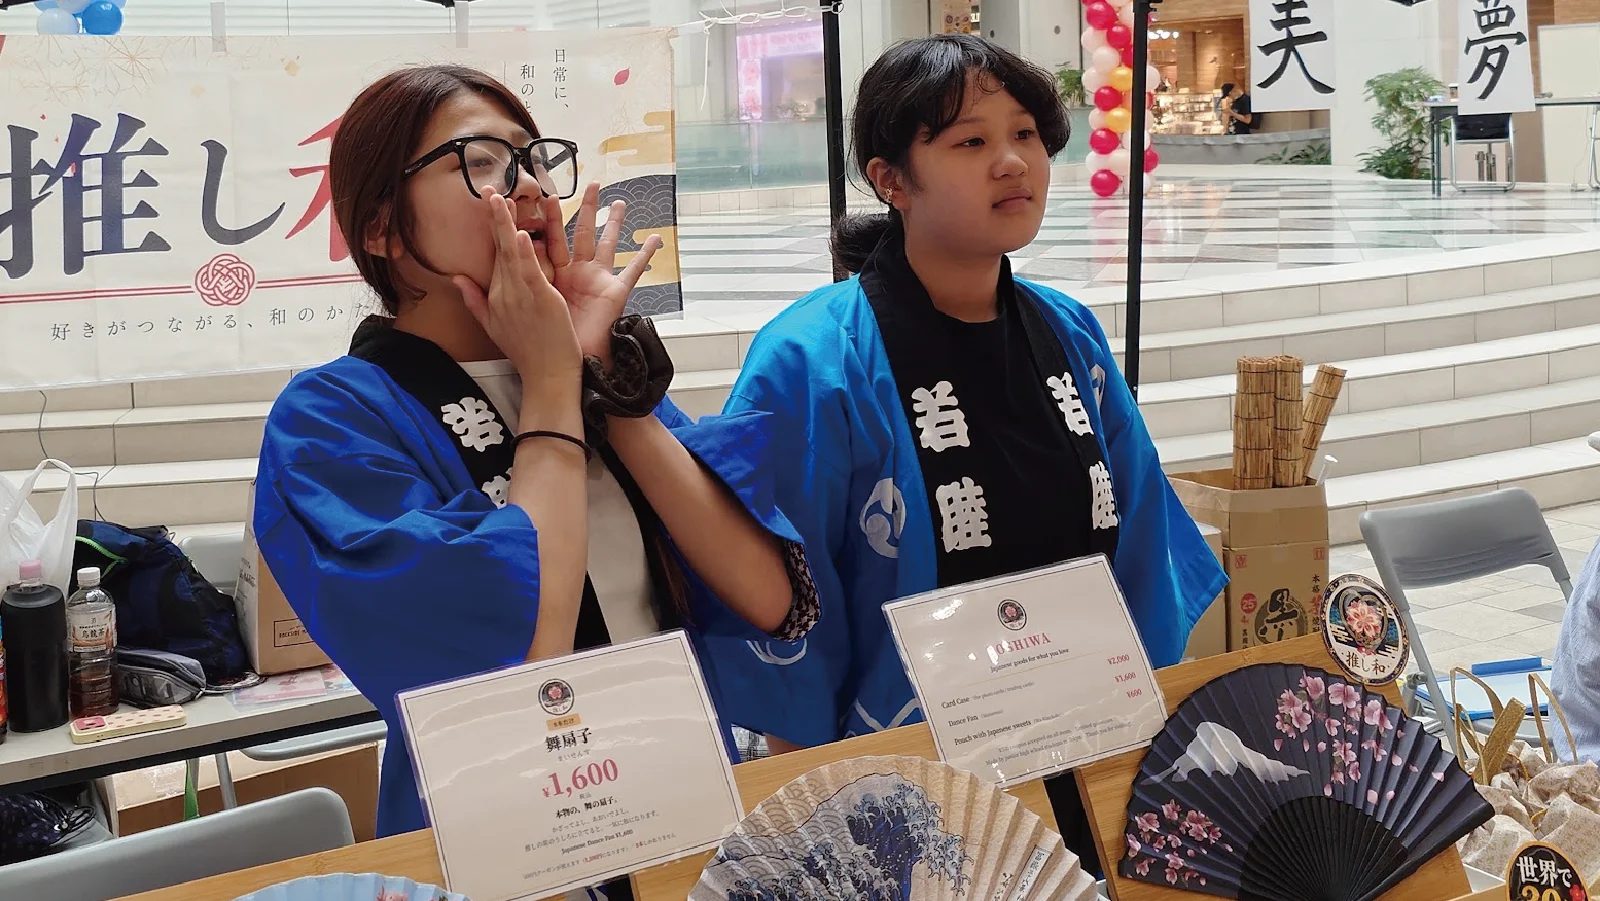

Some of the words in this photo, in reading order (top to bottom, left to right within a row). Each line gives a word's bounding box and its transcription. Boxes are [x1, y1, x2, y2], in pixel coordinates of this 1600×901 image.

[1256, 0, 1336, 94] 美
[1464, 0, 1527, 99] 夢
[553, 49, 569, 108] 日常に、
[996, 633, 1051, 654] OSHIWA
[1108, 654, 1130, 664] ¥2,000
[1346, 651, 1386, 675] 推し和
[1114, 672, 1136, 682] ¥1,600
[948, 718, 965, 727] Dance
[954, 735, 972, 746] Pouch
[973, 731, 986, 740] with
[987, 726, 1012, 737] Japanese
[1012, 720, 1032, 729] sweets
[545, 728, 592, 753] 舞扇子
[542, 758, 618, 798] ¥1,600
[1516, 856, 1572, 888] 世界で
